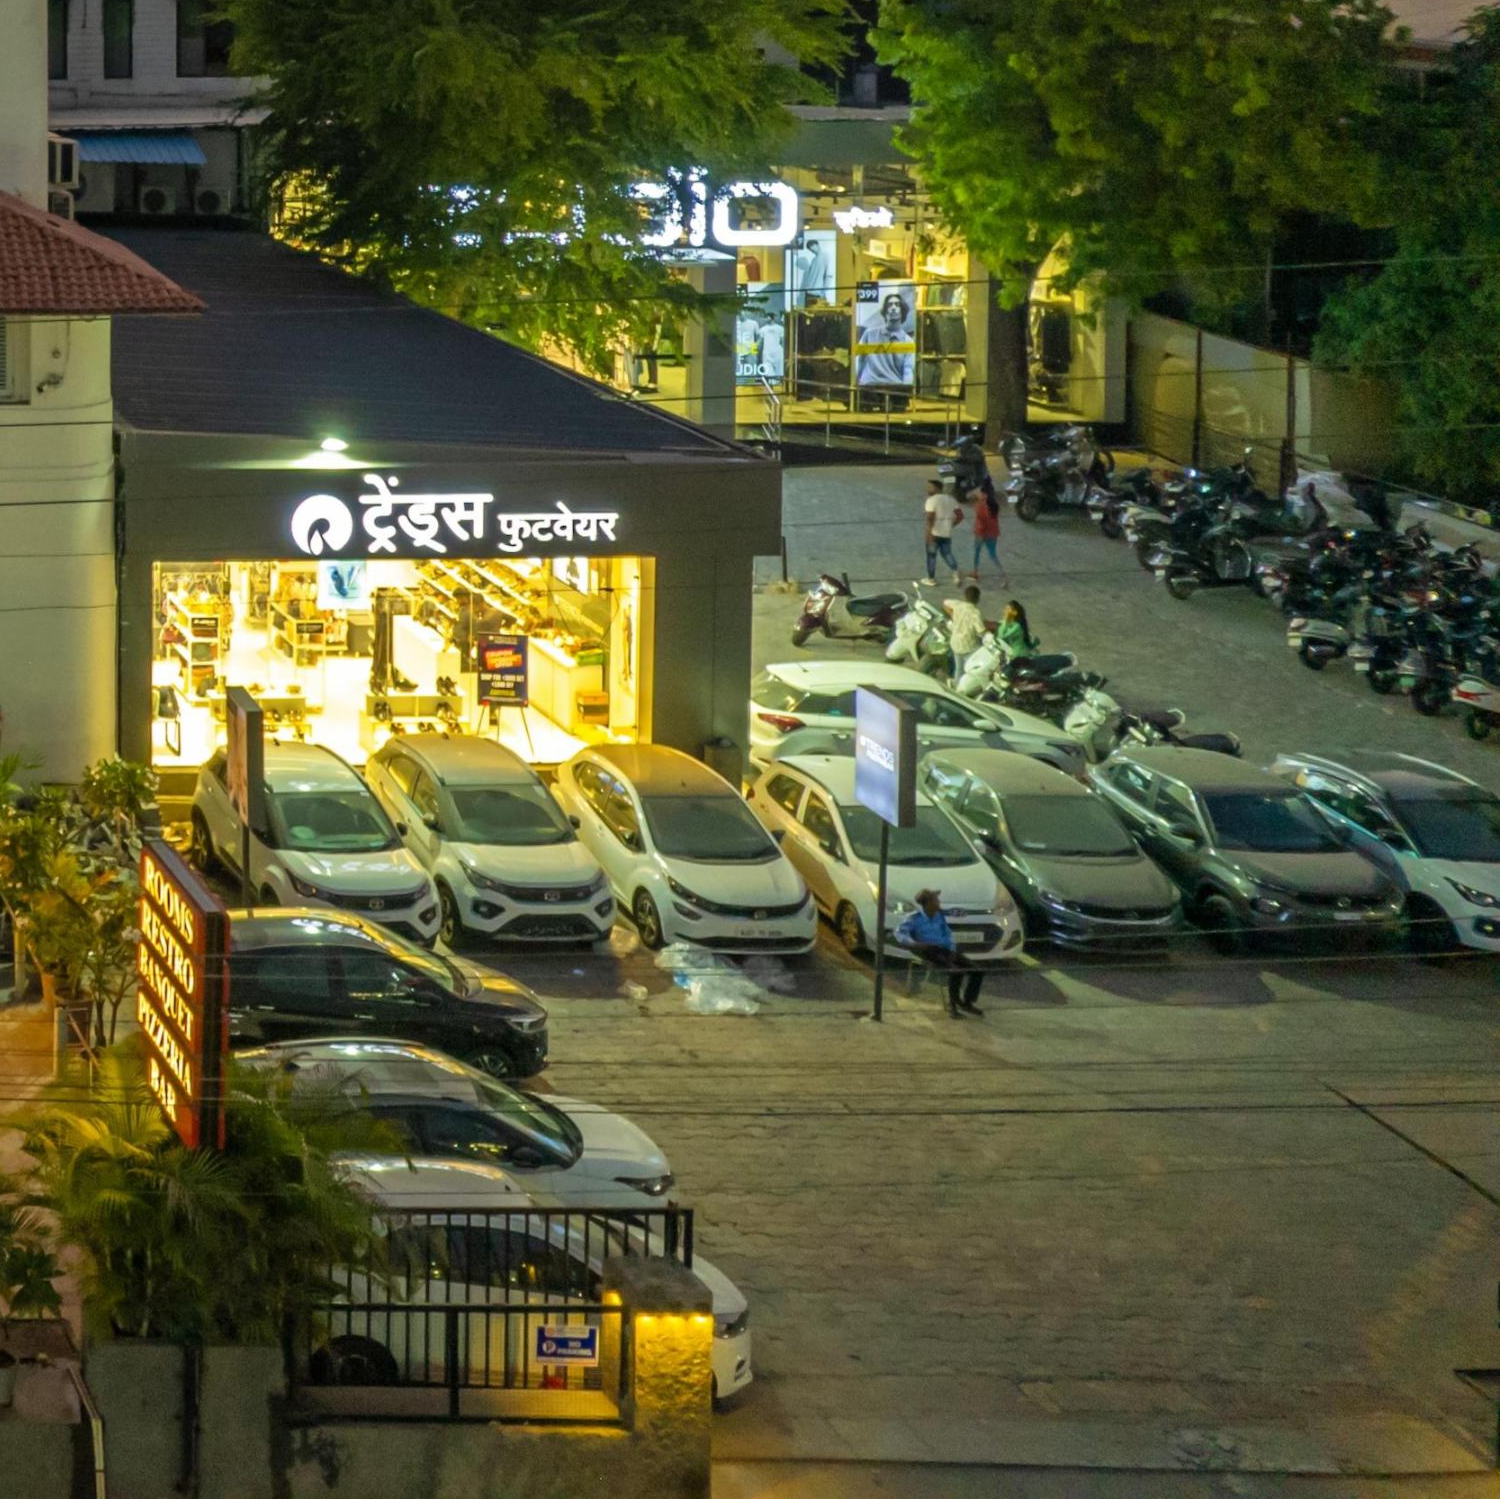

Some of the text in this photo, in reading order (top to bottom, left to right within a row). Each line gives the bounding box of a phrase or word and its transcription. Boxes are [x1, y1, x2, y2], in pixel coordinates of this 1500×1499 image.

[359, 473, 620, 554] ट्रेंड्स फुटवेयर
[141, 898, 194, 994] RESTRO
[144, 856, 194, 945] ROOMS
[139, 941, 194, 1041] BANQUET
[137, 991, 192, 1097] PIZZERIA
[150, 1057, 177, 1123] BAR
